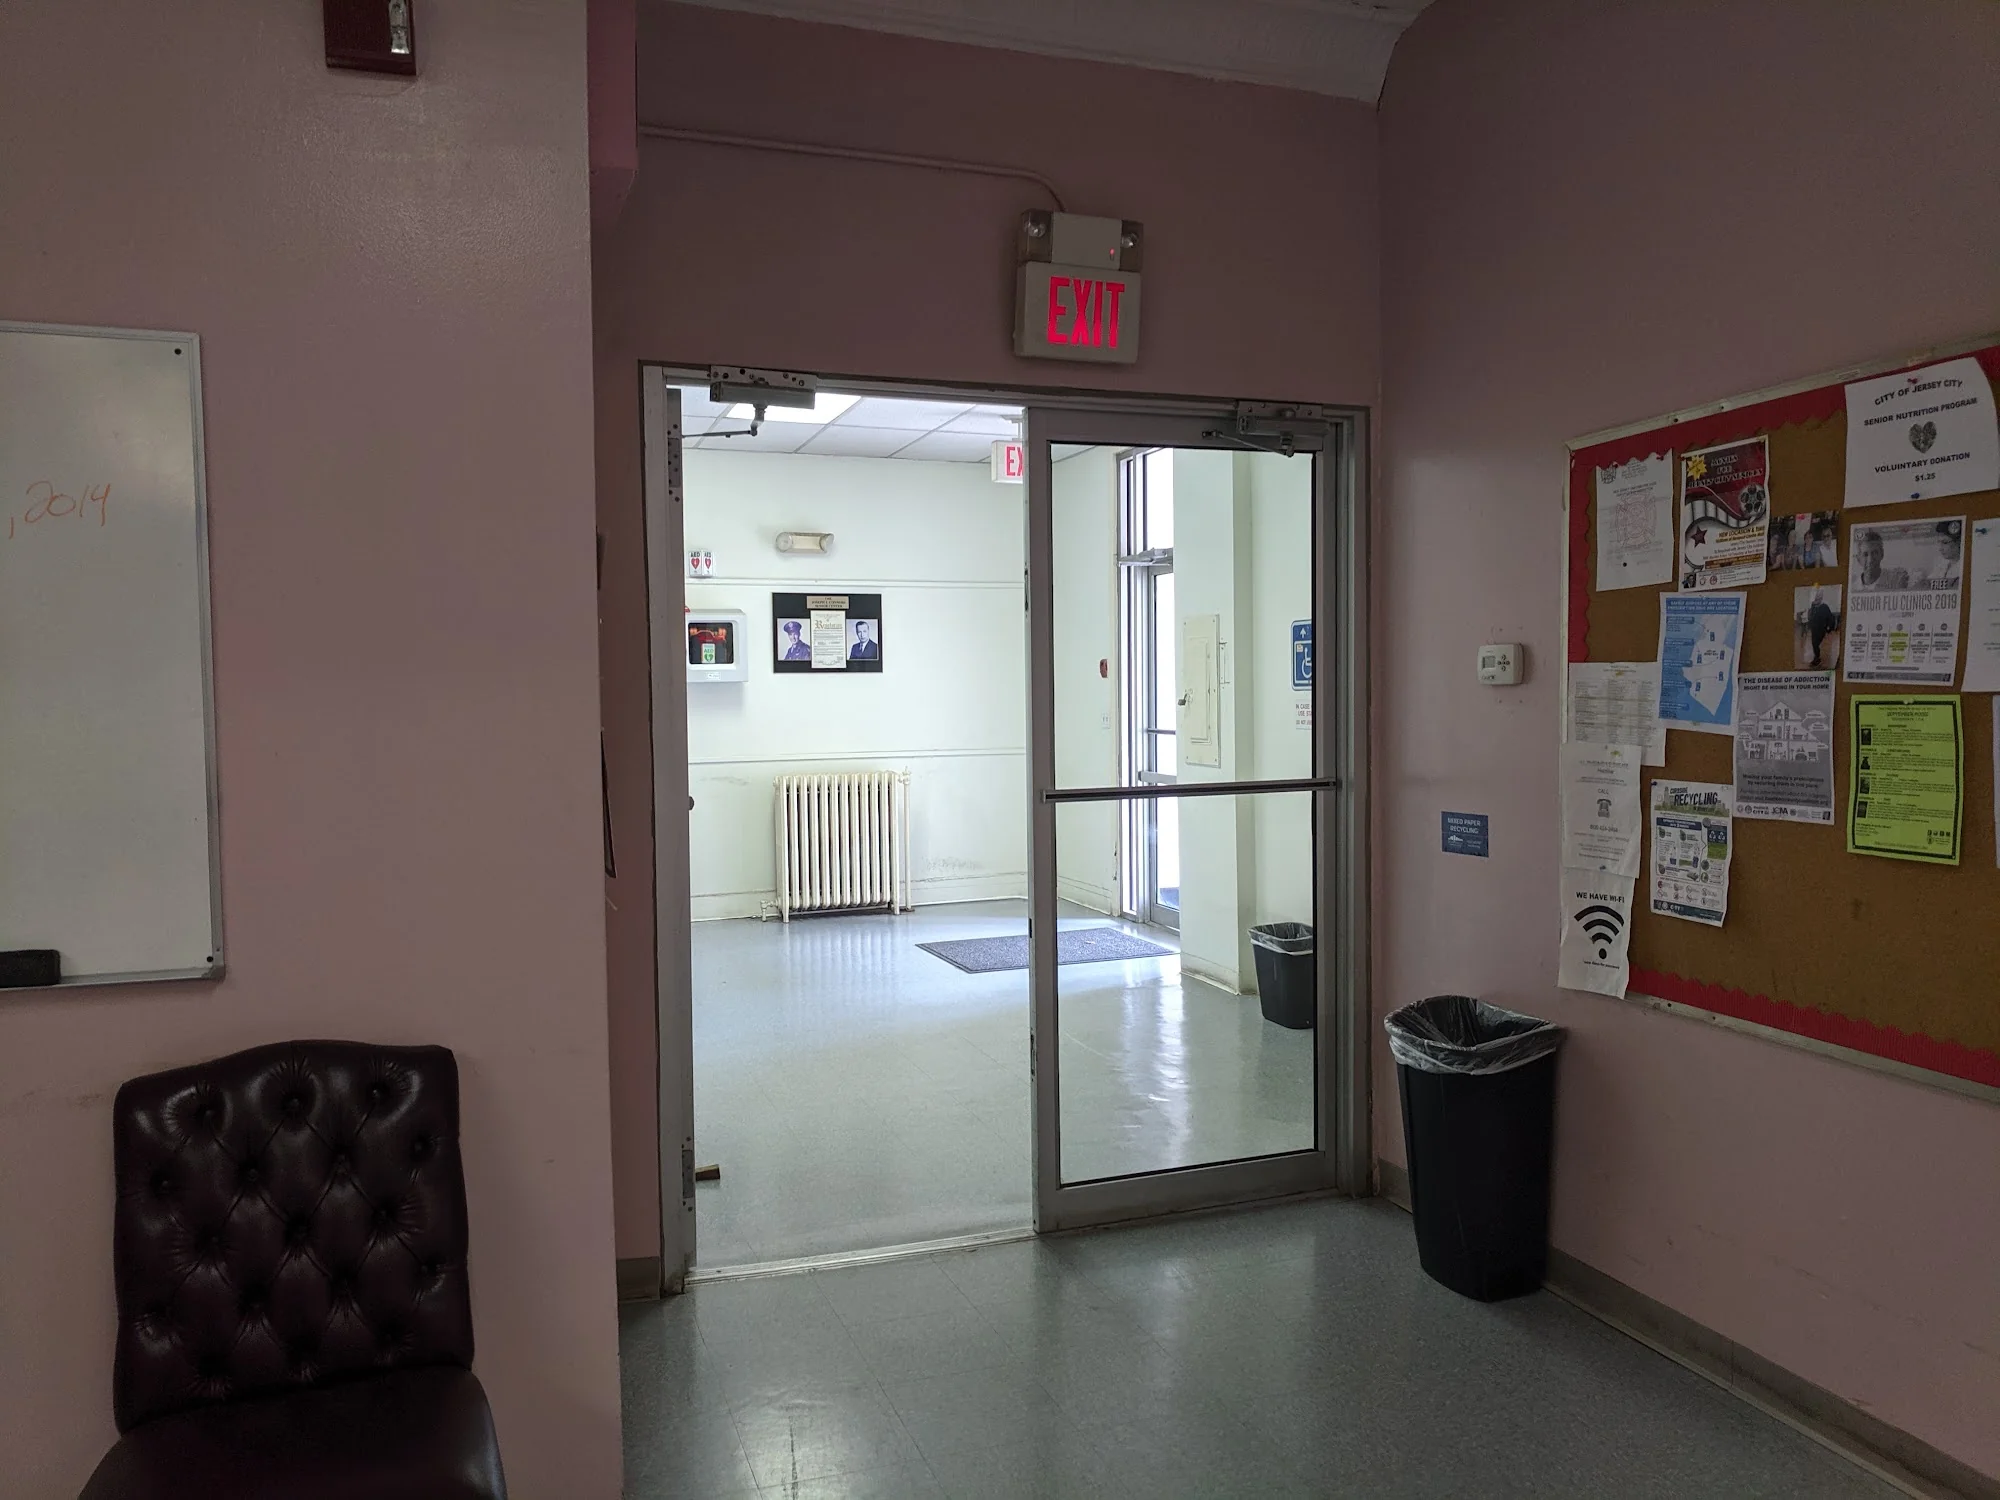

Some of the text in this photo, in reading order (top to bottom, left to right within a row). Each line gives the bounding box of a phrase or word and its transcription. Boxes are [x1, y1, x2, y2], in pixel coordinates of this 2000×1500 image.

[1047, 277, 1125, 348] EXIT
[1875, 379, 1962, 405] CITY OF JERSEY CITY
[1864, 398, 1977, 426] SENIOR NUTRITION PROGRAM
[1930, 452, 1970, 465] DONATION
[1915, 473, 1936, 481] $1.25
[1931, 580, 1948, 591] FREE
[1851, 594, 1958, 612] SENIOR FLU CLINICS 2019
[1674, 792, 1718, 806] RECYCLING
[1450, 825, 1479, 834] RECYCLING
[1464, 819, 1480, 827] PAPER
[1590, 893, 1608, 901] HAVE
[1610, 895, 1625, 903] WI-FI
